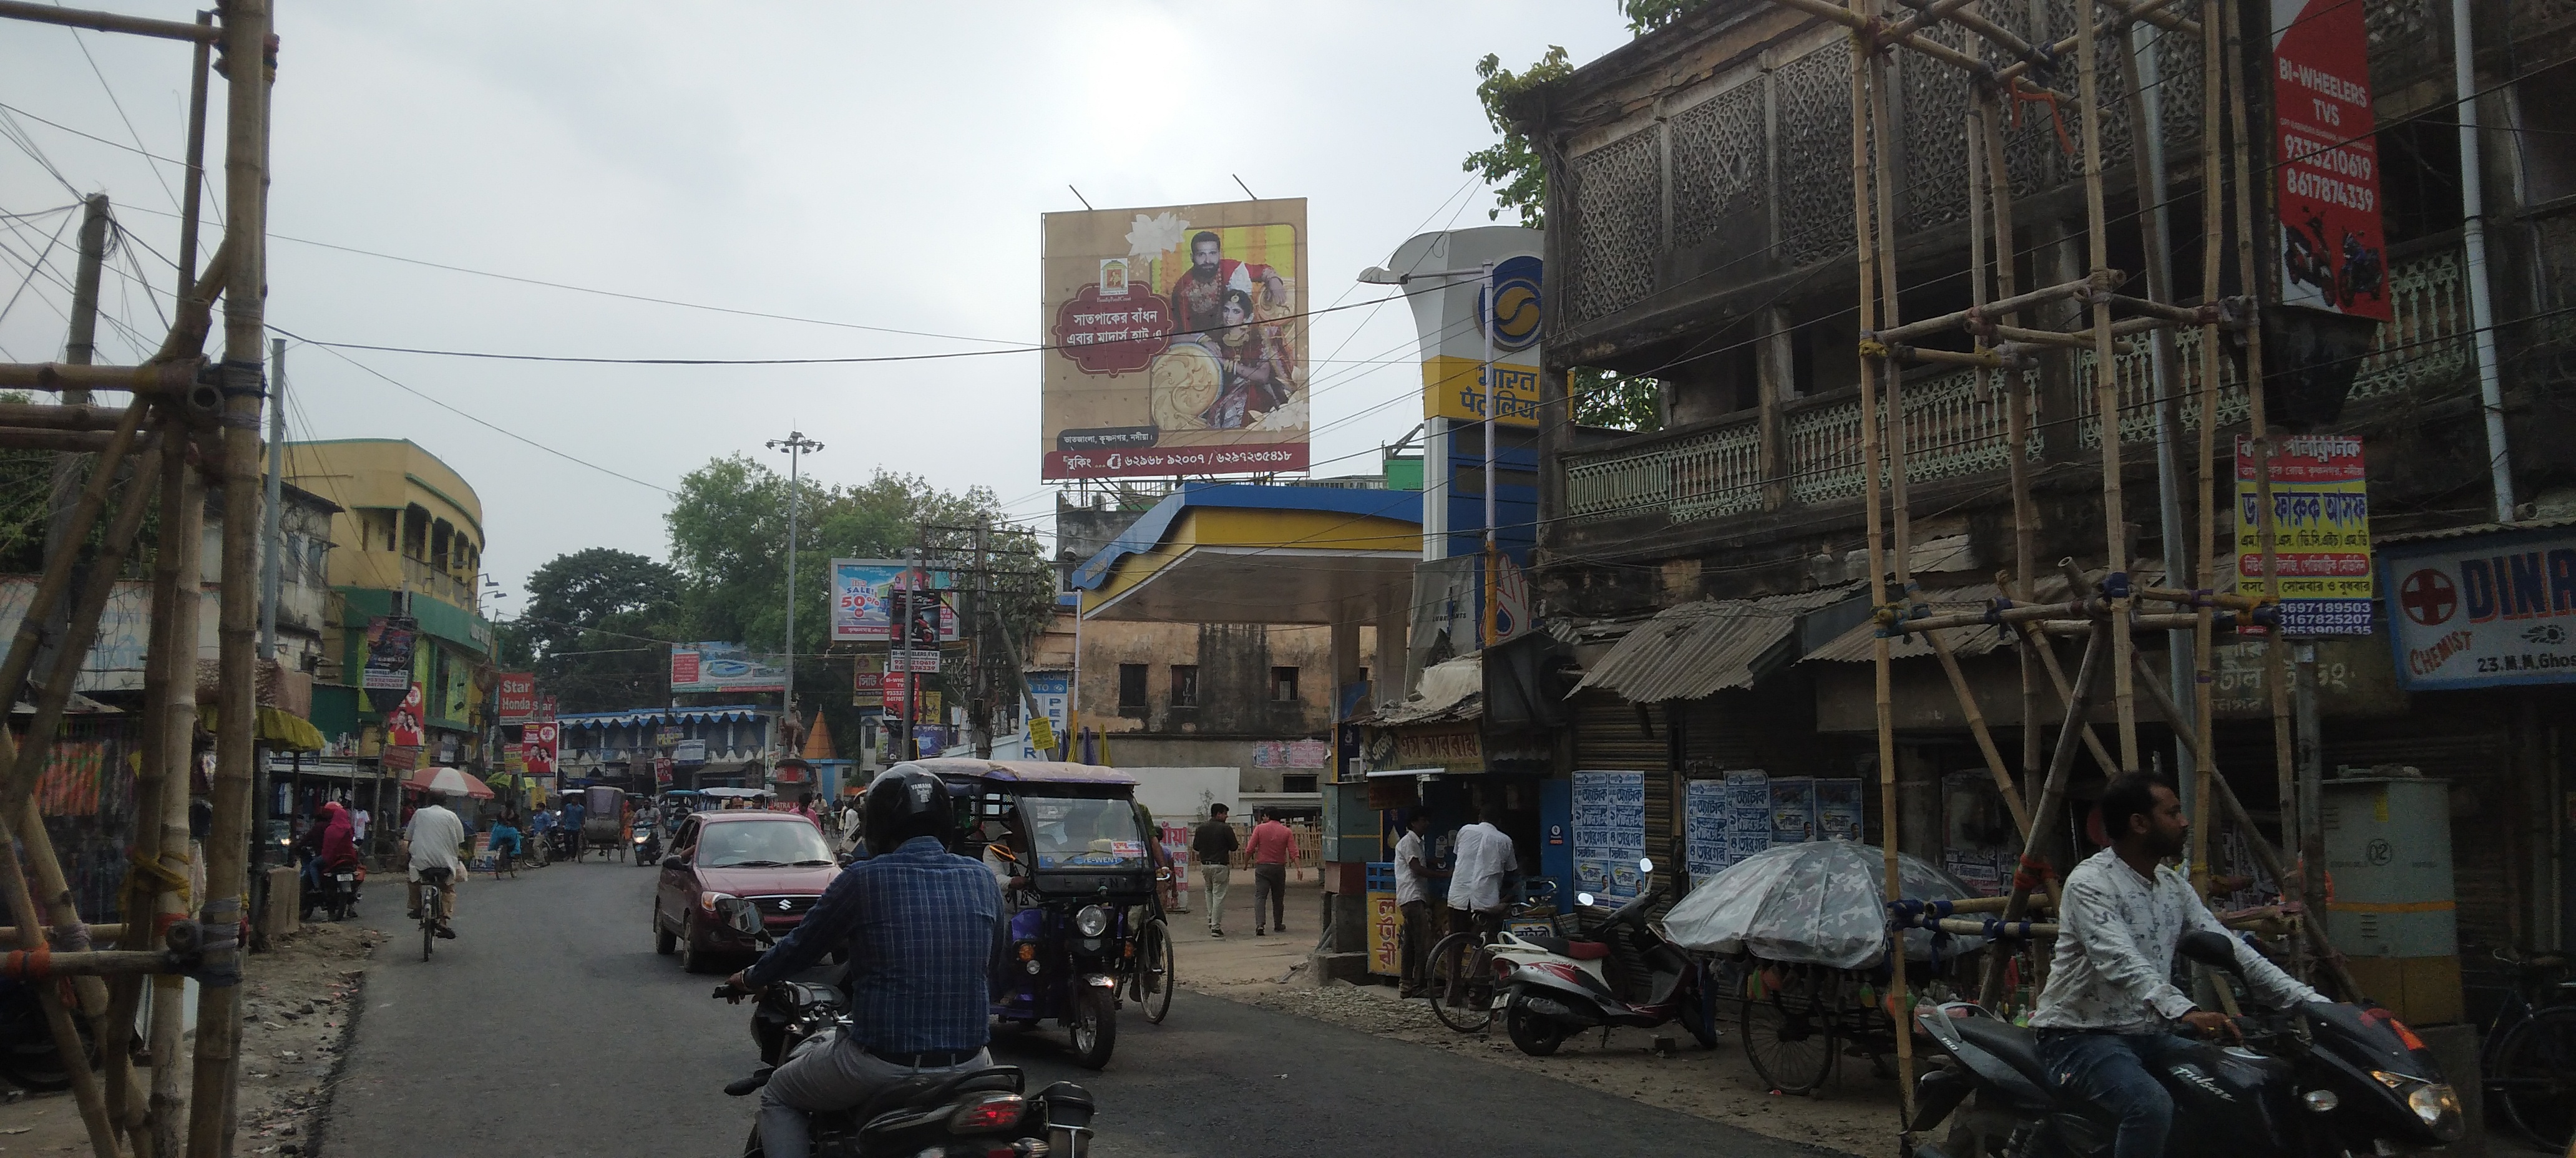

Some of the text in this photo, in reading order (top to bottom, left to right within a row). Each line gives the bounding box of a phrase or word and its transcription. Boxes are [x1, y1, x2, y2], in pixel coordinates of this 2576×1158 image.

[2279, 57, 2367, 108] BI-WHEELERS
[2313, 98, 2339, 127] TVS
[2285, 134, 2371, 180] 9333210619
[2287, 167, 2373, 212] 8617874339
[1073, 307, 1158, 326] সাতপাকের বাঁধন
[1067, 326, 1162, 345] এবার মাদার্স হাট এ
[1067, 455, 1091, 470] বুকিং
[1125, 455, 1163, 466] ৬২৯৬৮
[1168, 454, 1205, 465] ৯২০০৭
[2272, 487, 2321, 529] ফারুক
[2281, 581, 2324, 593] সোমবার
[2327, 581, 2335, 591] ও
[2338, 581, 2370, 595] বুধবার
[841, 595, 881, 608] 50%
[2409, 630, 2473, 675] CHEMIST
[503, 680, 530, 693] Star
[859, 674, 877, 686] সিটি
[1037, 684, 1049, 692] TO
[502, 697, 530, 710] Honda
[2170, 1065, 2238, 1103] Pulsar
